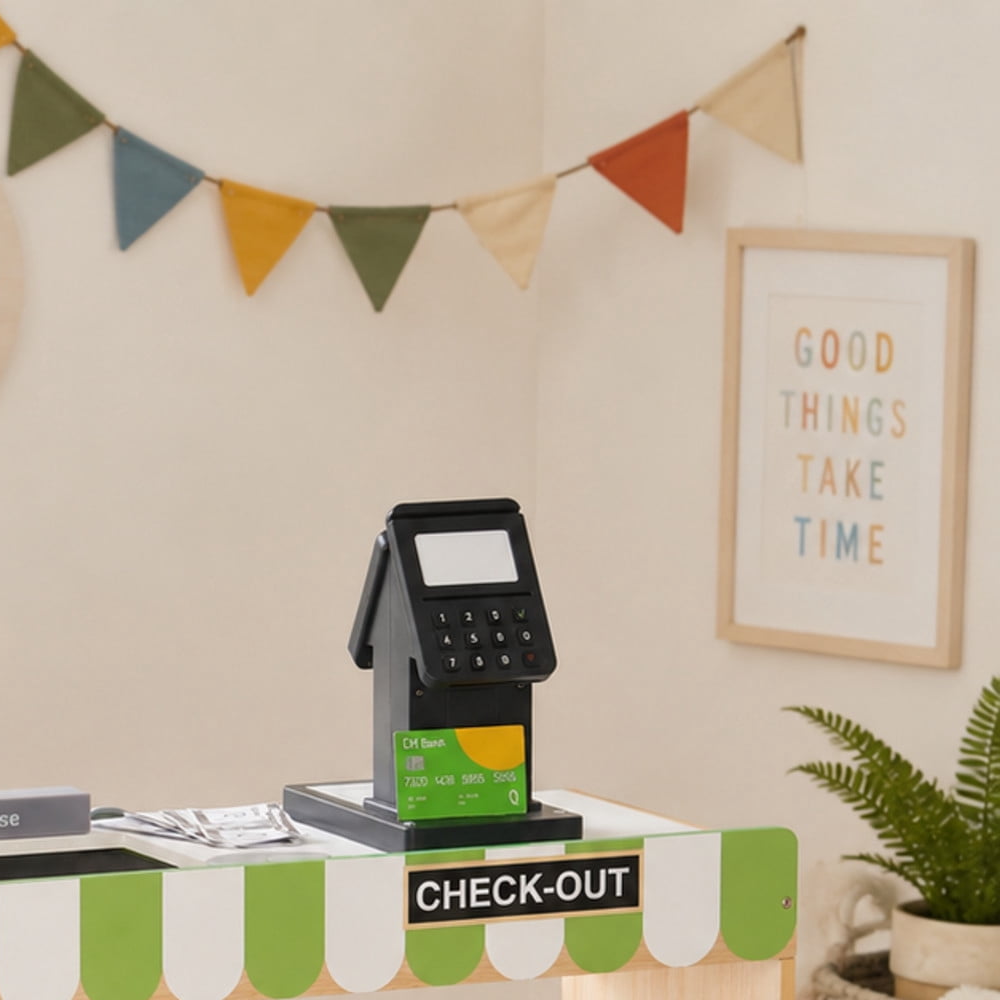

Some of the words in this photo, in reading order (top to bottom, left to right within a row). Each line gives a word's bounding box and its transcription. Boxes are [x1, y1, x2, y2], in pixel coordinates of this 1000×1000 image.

[794, 327, 895, 373] GOOD
[780, 391, 908, 439] THINGS
[796, 453, 885, 500] TAKE
[793, 516, 885, 565] TIME
[416, 867, 630, 911] CHECK-OUT
